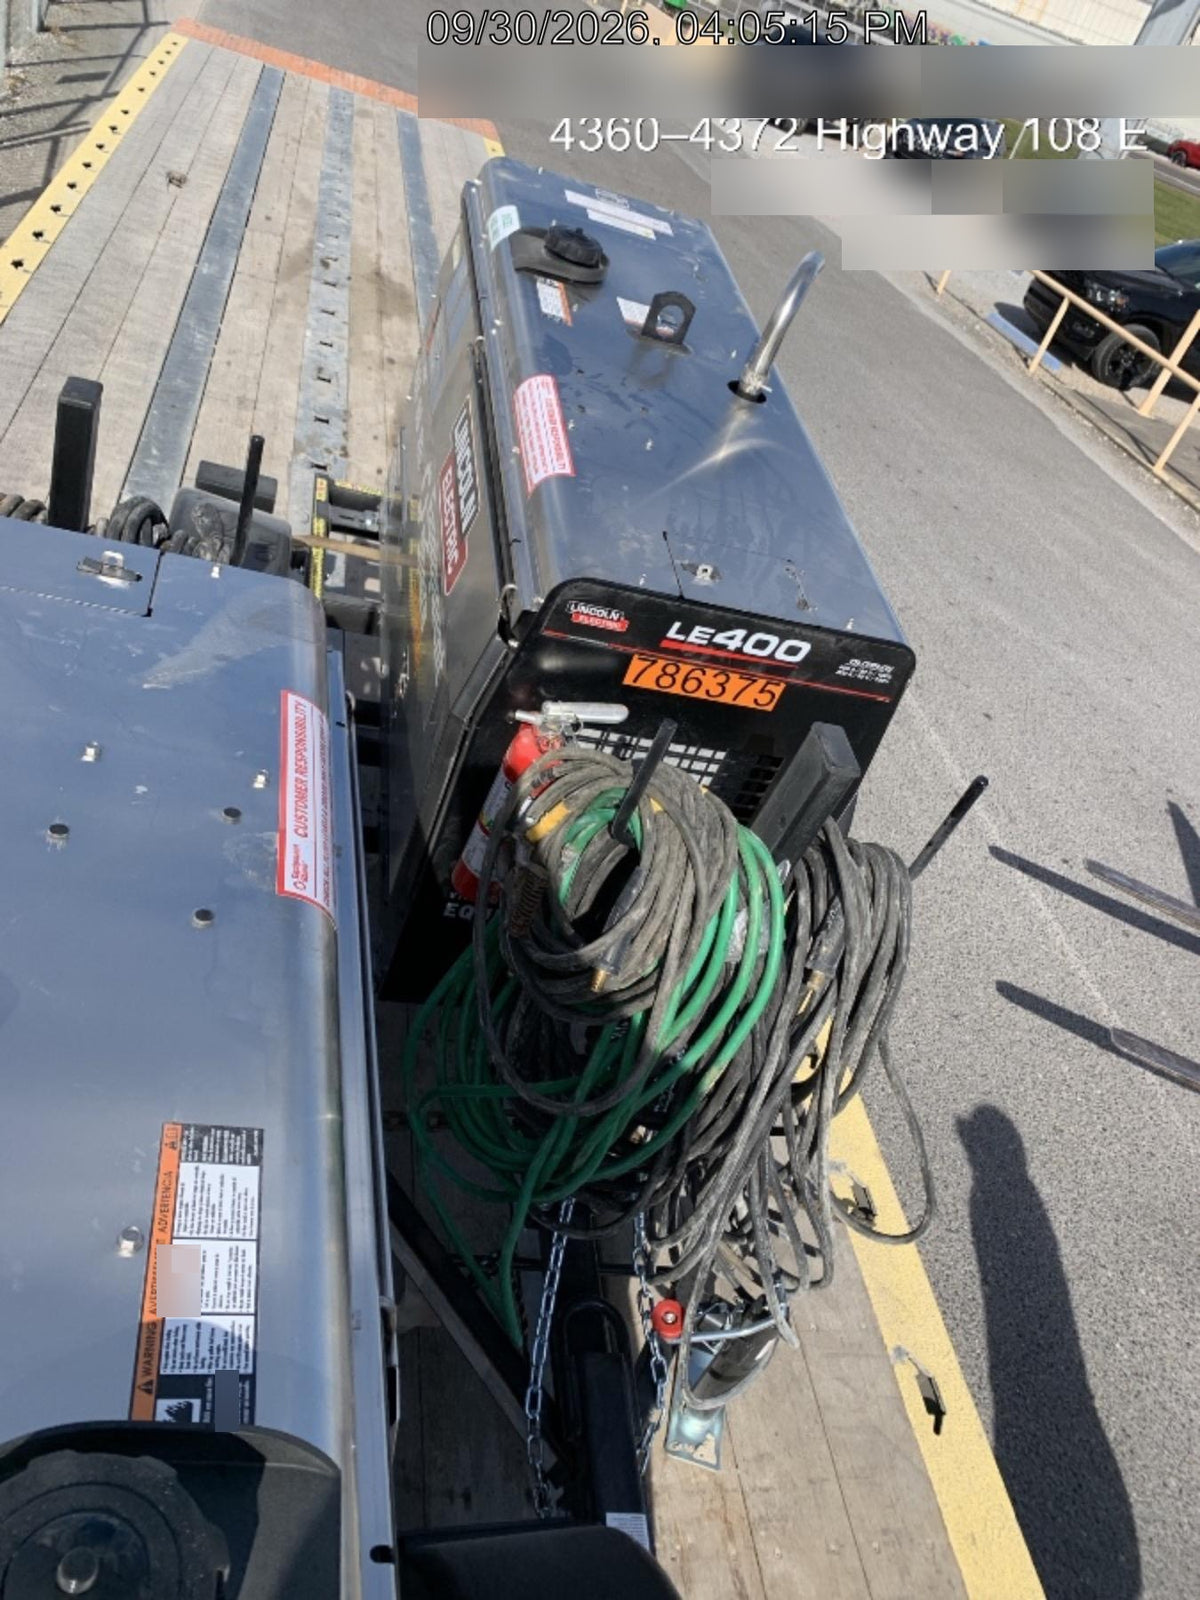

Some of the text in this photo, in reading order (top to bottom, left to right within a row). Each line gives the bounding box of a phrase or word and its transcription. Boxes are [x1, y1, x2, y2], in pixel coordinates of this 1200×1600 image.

[569, 602, 621, 621] LINCOLN
[665, 620, 812, 664] LE400
[630, 656, 778, 709] 786375
[294, 701, 309, 839] CUSTOMER RESPONSIBILITY
[143, 1319, 158, 1376] WARNING
